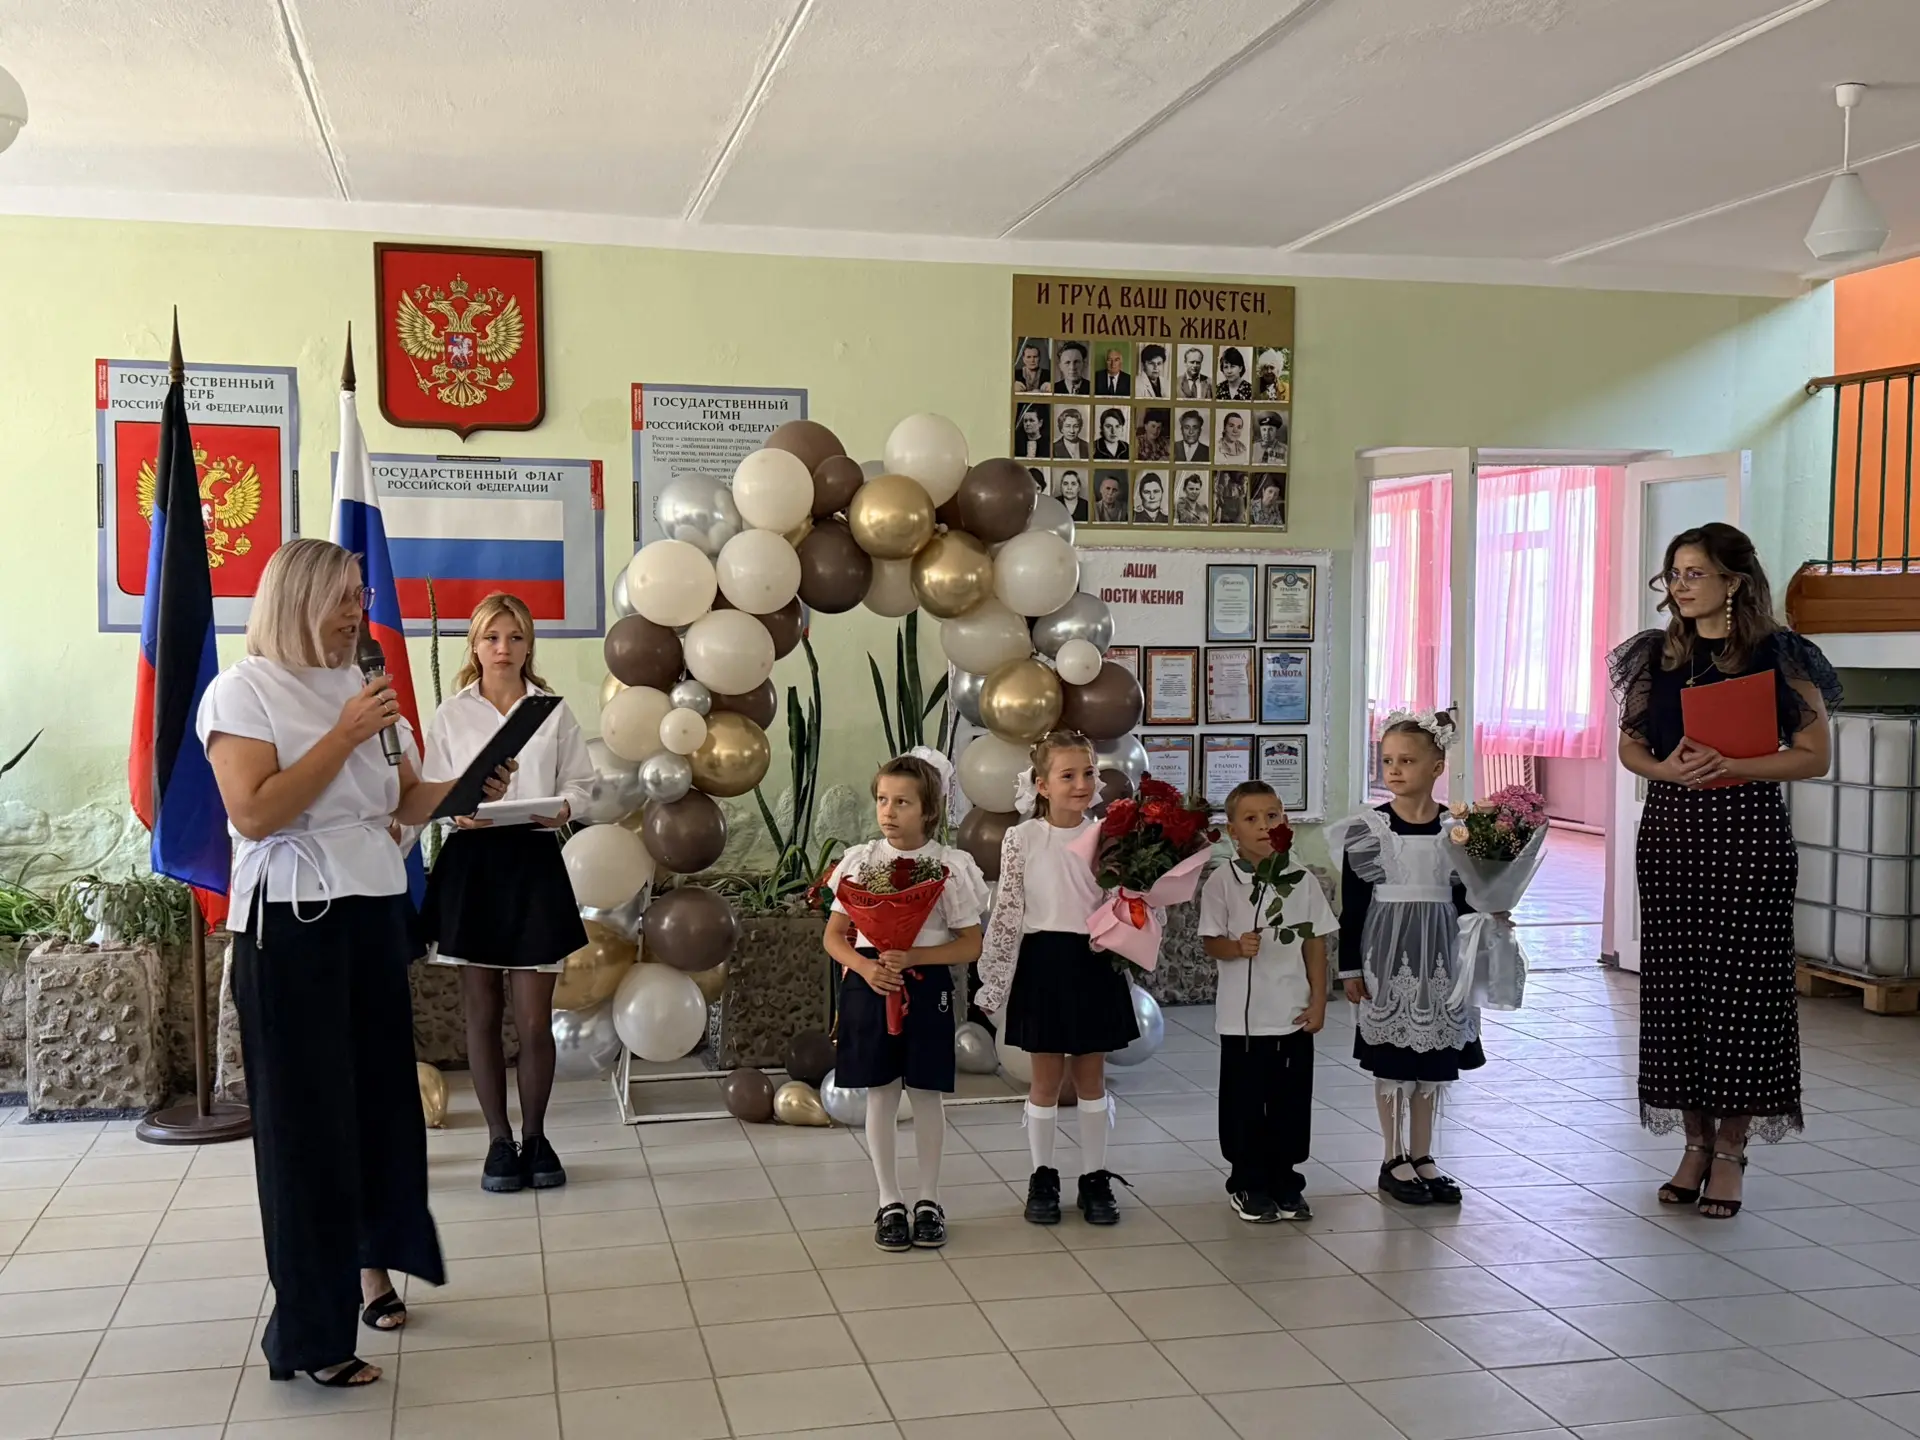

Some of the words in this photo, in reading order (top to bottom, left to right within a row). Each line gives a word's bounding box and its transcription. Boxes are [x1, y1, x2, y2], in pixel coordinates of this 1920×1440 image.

[1037, 282, 1050, 305] И
[1058, 283, 1112, 310] ТРУД
[1120, 285, 1167, 310] ВАШ
[1175, 288, 1272, 316] ПОЧЕТЕН,
[1061, 312, 1074, 334] И
[1082, 313, 1172, 338] ПАМЯТЬ
[1179, 316, 1248, 341] ЖИВА!
[119, 373, 275, 390] ГОСУДРСТВЕННЫЙ
[111, 399, 200, 412] РОССИЙОЙ
[205, 402, 284, 415] ФЕДЕРАЦИИ
[652, 396, 789, 411] ГОСУДАРСТВЕННЫЙ
[702, 410, 741, 420] ГИМН
[645, 420, 725, 432] РОССИЙСКОЙ
[371, 465, 518, 481] ГОСУДАРСТВЕННЫЙ
[525, 470, 565, 482] ФЛАГ
[387, 480, 471, 491] РОССИЙСКОЙ
[476, 482, 549, 493] ФЕДЕРАЦИИ
[1268, 669, 1303, 678] ГРАМОТА
[1266, 758, 1298, 766] ГРАМОТА
